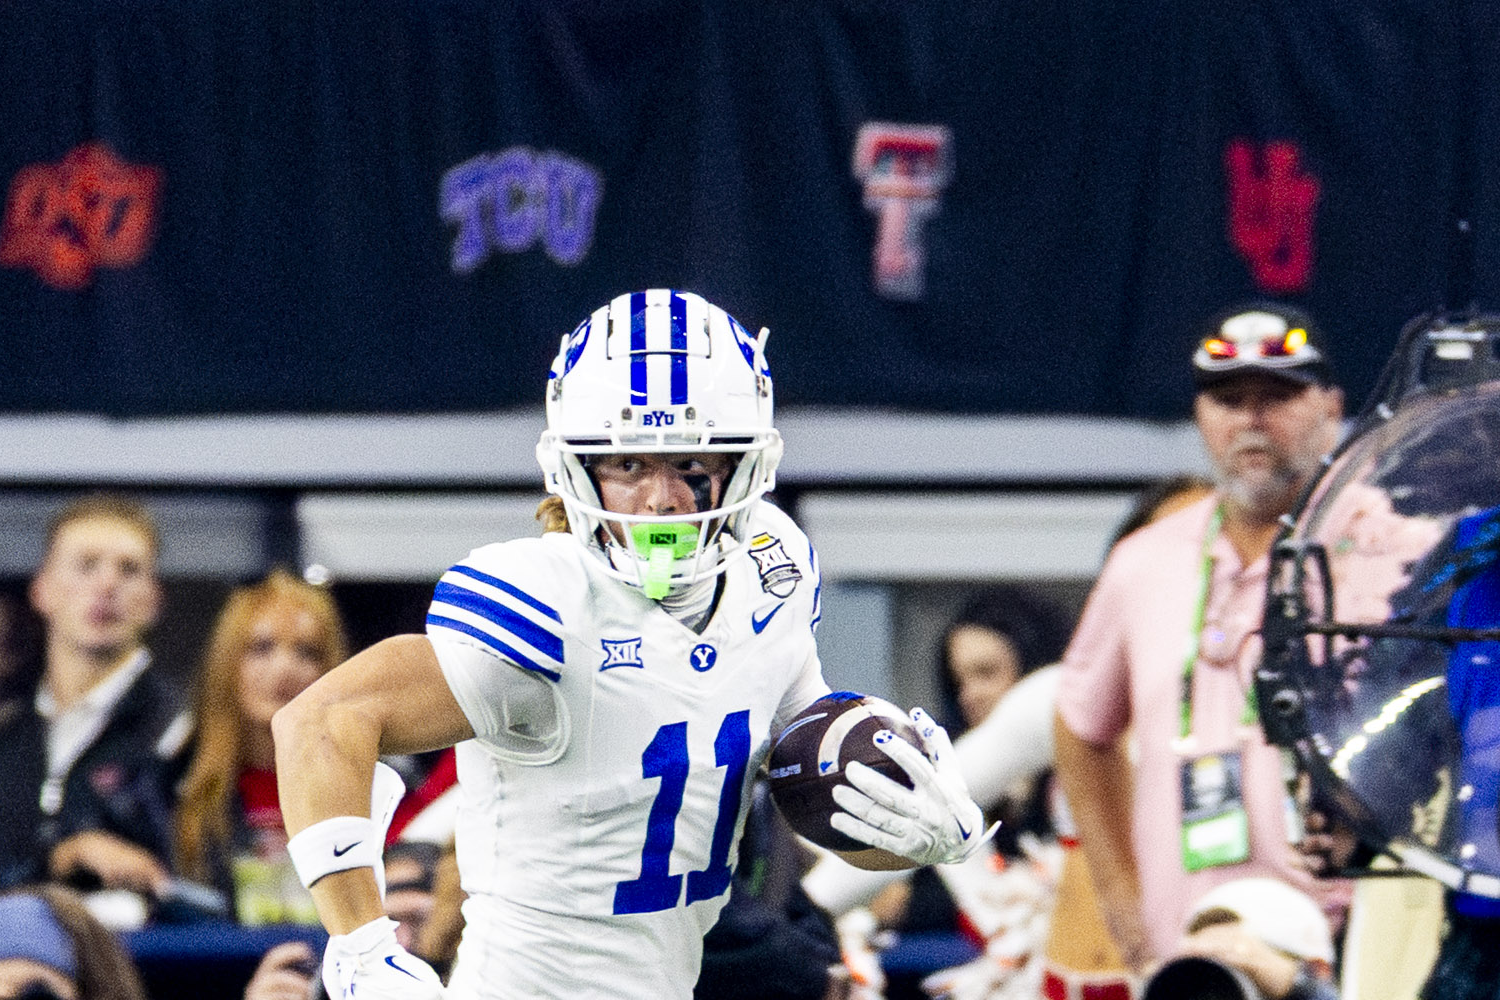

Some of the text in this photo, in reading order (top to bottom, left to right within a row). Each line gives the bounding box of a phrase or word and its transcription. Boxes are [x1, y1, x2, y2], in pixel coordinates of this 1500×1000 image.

[440, 146, 602, 271] TCU
[643, 411, 674, 427] BYU
[692, 645, 715, 669] Y
[613, 709, 751, 915] 11
